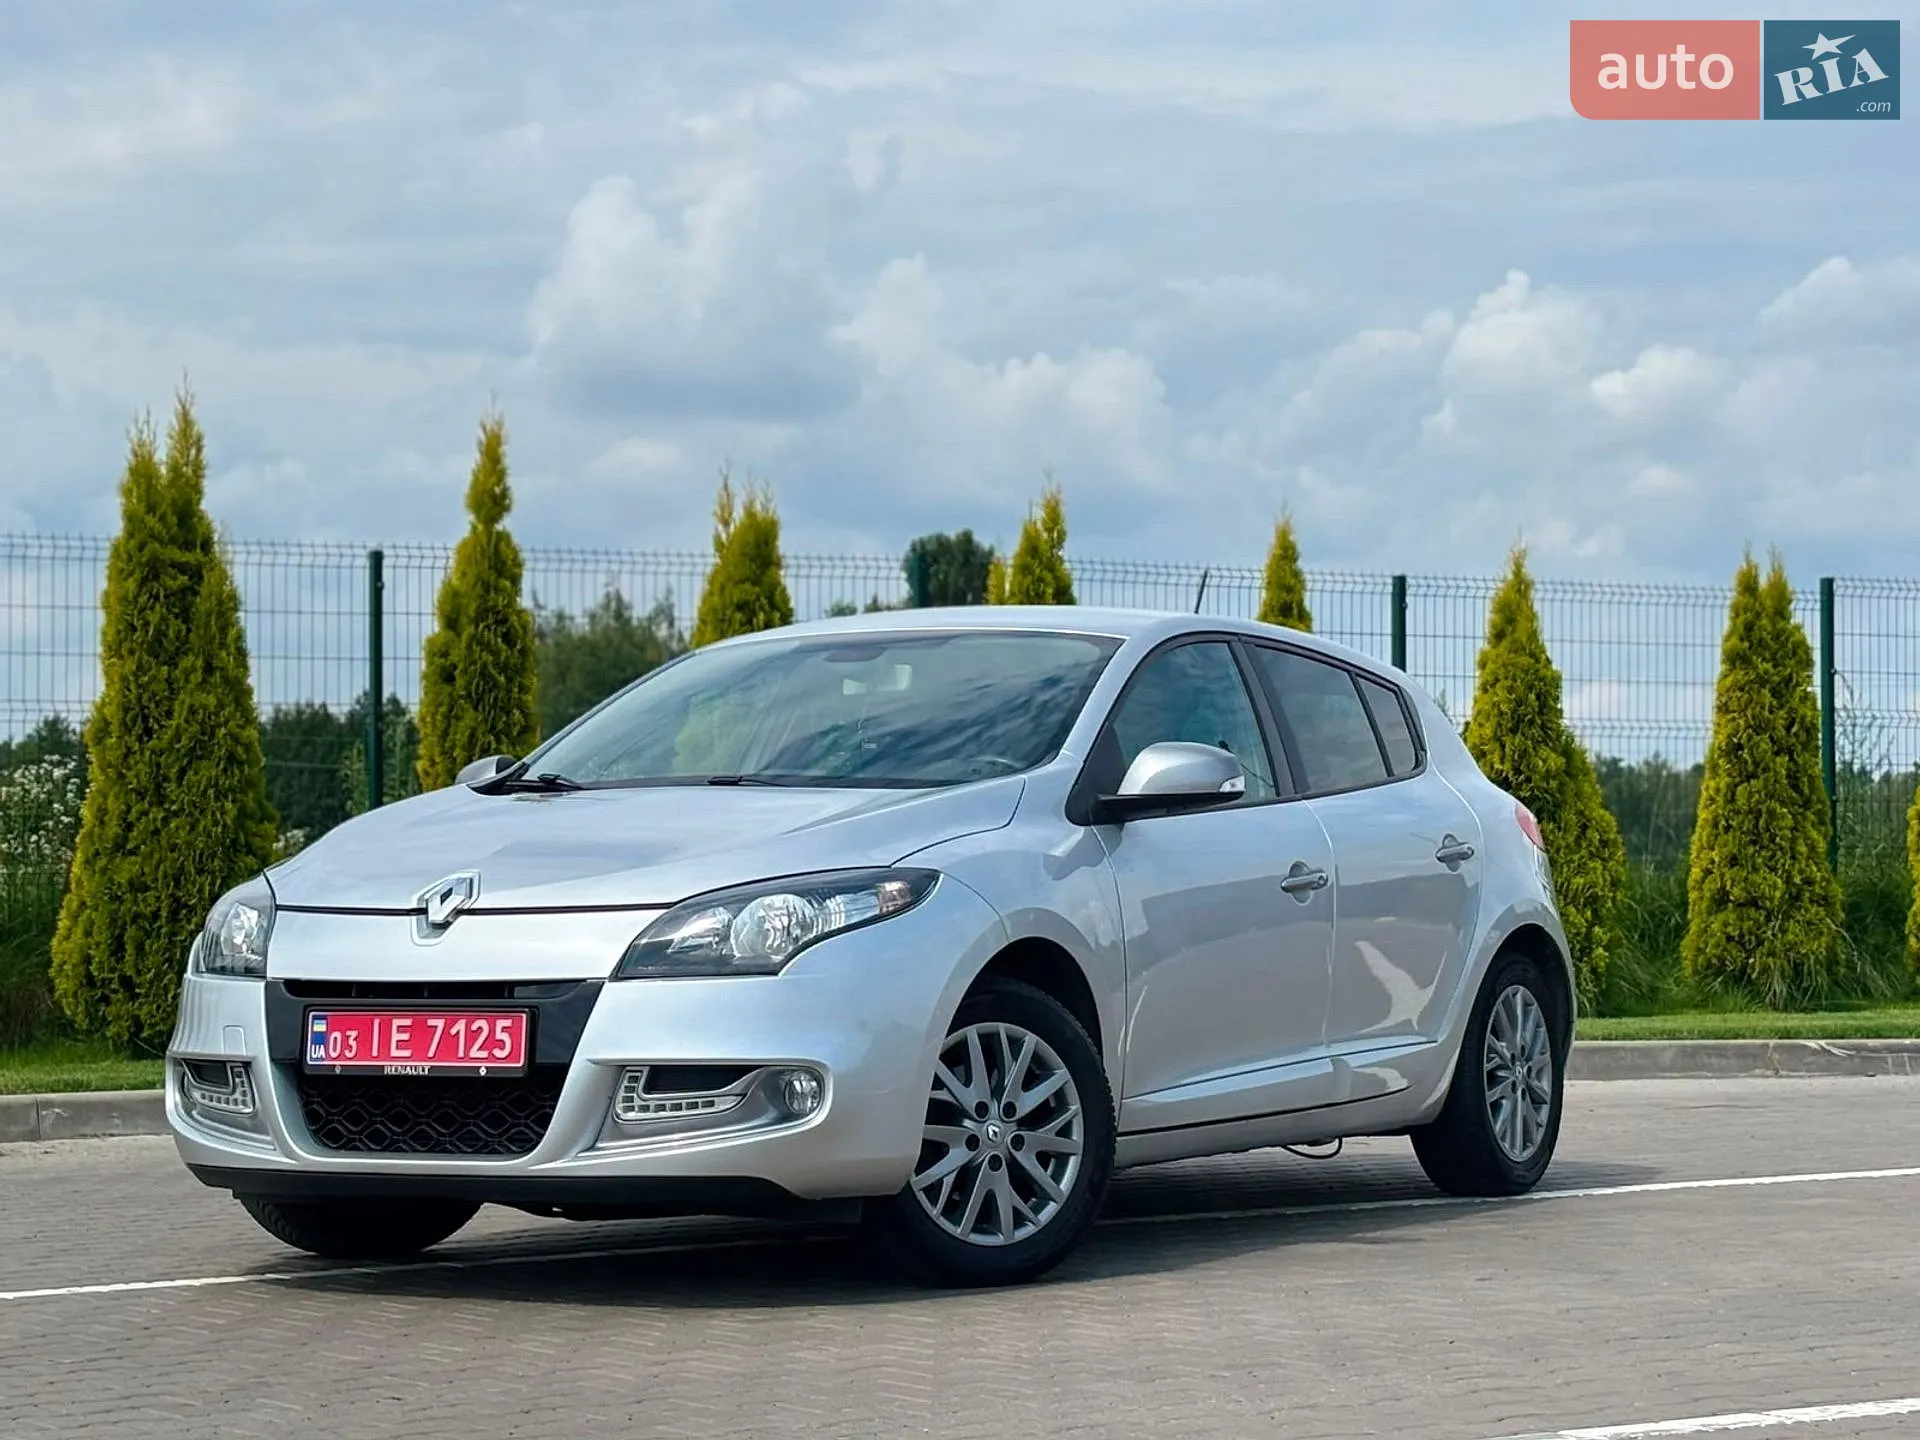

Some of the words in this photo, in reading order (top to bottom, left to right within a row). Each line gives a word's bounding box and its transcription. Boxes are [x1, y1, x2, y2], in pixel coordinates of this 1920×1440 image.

[329, 1030, 359, 1059] 03
[371, 1018, 413, 1058] IE
[426, 1018, 513, 1059] 7125
[311, 1044, 326, 1059] UA
[384, 1065, 432, 1076] RENAULT
